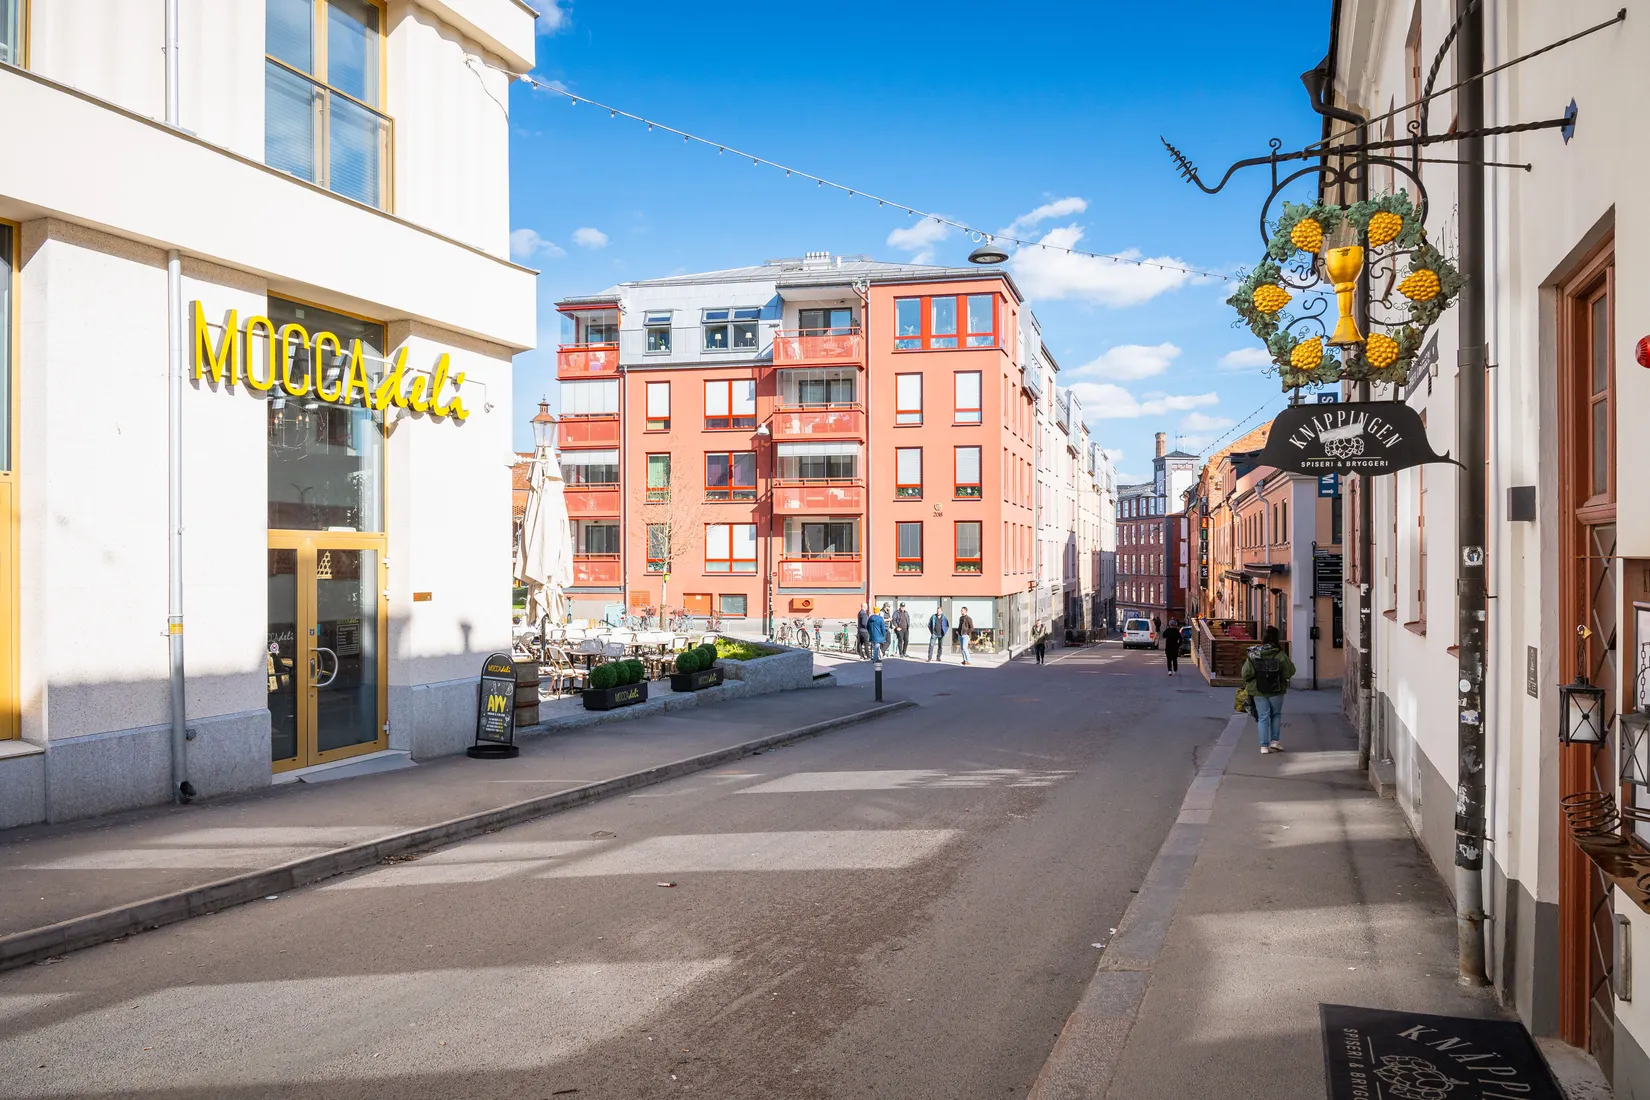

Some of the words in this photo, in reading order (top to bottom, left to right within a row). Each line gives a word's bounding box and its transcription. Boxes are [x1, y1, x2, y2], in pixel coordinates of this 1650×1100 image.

[190, 300, 470, 420] MOCCAdeli
[1289, 410, 1403, 449] KNÄPPINGEN
[1343, 1028, 1363, 1060] SPISERI
